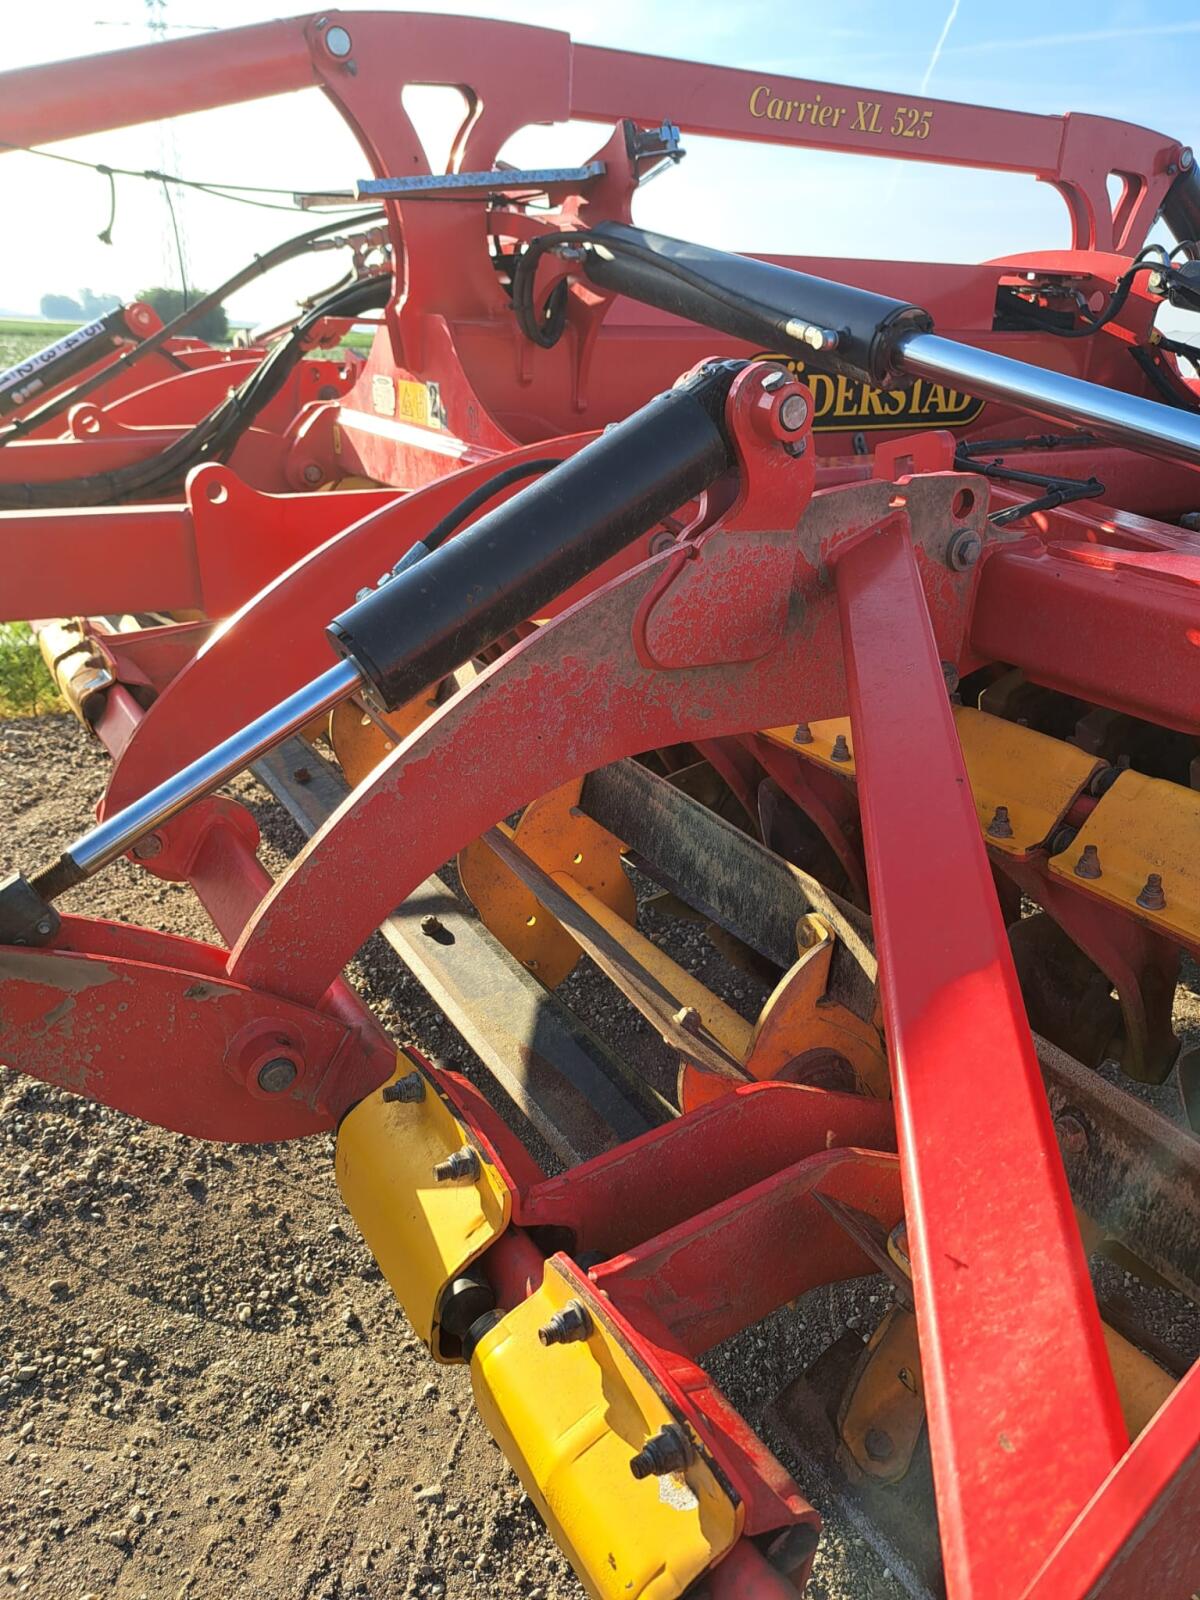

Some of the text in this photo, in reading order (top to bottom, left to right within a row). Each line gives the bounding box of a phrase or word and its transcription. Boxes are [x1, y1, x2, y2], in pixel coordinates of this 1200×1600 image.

[750, 86, 933, 139] Carrier XL 525
[17, 364, 33, 377] 2
[41, 350, 56, 362] 3
[788, 361, 972, 417] DERSTAD
